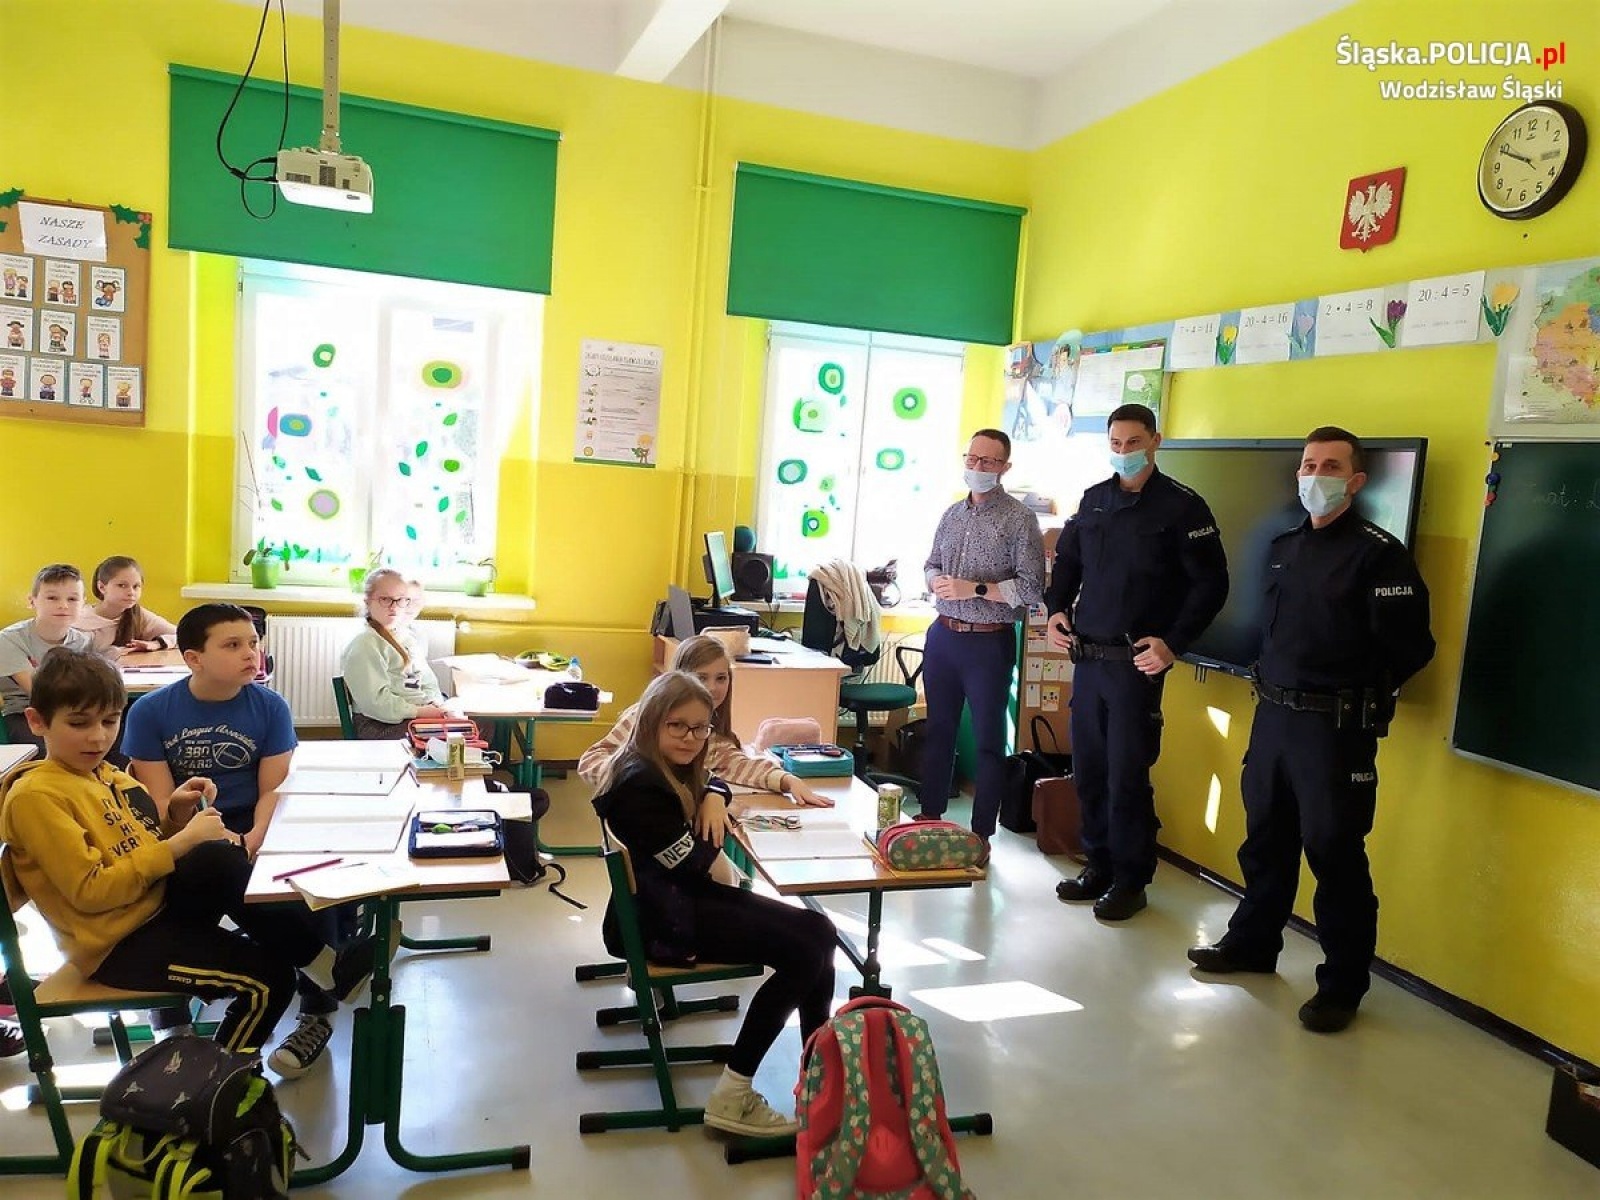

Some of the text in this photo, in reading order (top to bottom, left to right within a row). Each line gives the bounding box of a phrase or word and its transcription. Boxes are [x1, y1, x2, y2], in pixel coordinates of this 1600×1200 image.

[1527, 118, 1538, 132] 12
[1545, 119, 1550, 132] 1
[1513, 127, 1522, 140] 11
[1553, 130, 1561, 142] 2
[1494, 162, 1501, 174] 9
[1547, 166, 1555, 177] 4
[1496, 178, 1503, 190] 8
[1535, 181, 1542, 193] 5
[1506, 187, 1513, 200] 7
[1519, 189, 1527, 202] 6
[40, 216, 85, 229] NASZE
[38, 235, 92, 248] ZASADY
[1418, 289, 1431, 302] 20
[1441, 286, 1449, 298] 4
[1462, 283, 1471, 297] 5
[1325, 304, 1332, 316] 2
[1366, 299, 1373, 312] 8
[1278, 311, 1288, 324] 16
[1375, 586, 1414, 597] POLICJA
[180, 728, 214, 740] League
